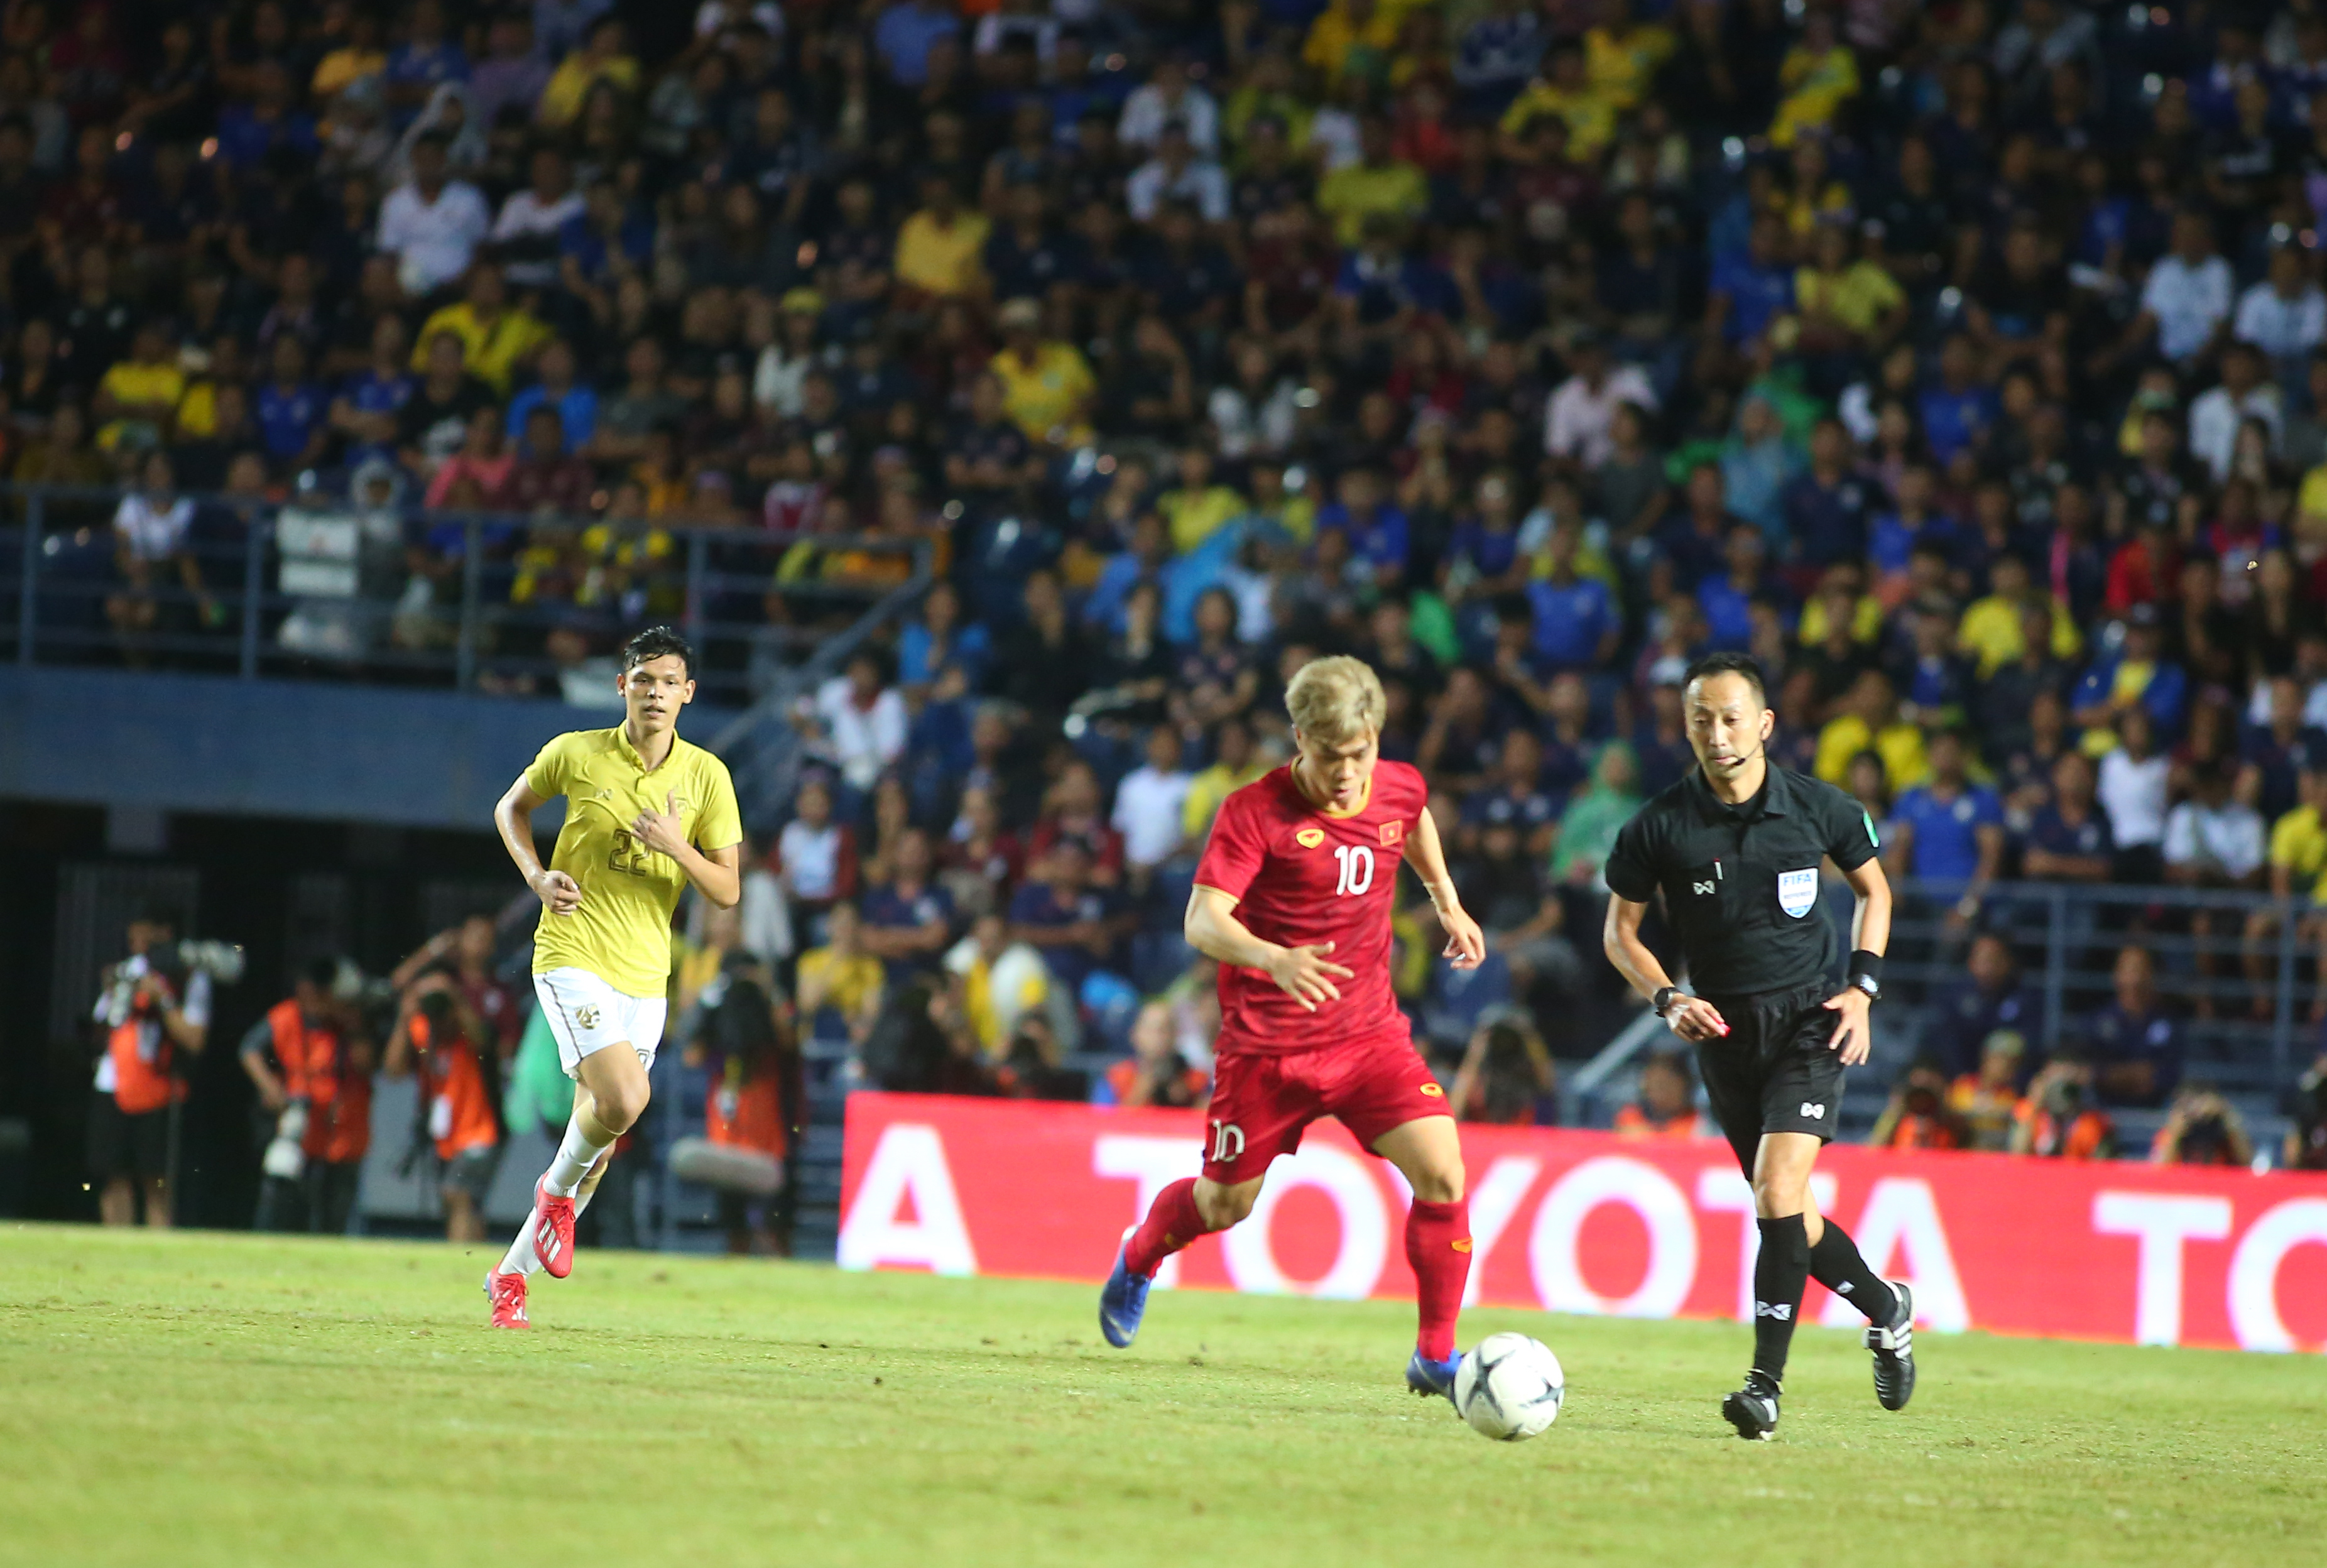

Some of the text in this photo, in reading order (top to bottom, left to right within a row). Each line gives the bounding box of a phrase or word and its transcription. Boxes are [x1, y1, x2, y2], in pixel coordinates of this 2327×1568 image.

[608, 828, 650, 877] 22
[1334, 844, 1375, 896] 10
[1783, 873, 1812, 886] FIFA
[1211, 1119, 1245, 1163] 10
[836, 1122, 979, 1278] A
